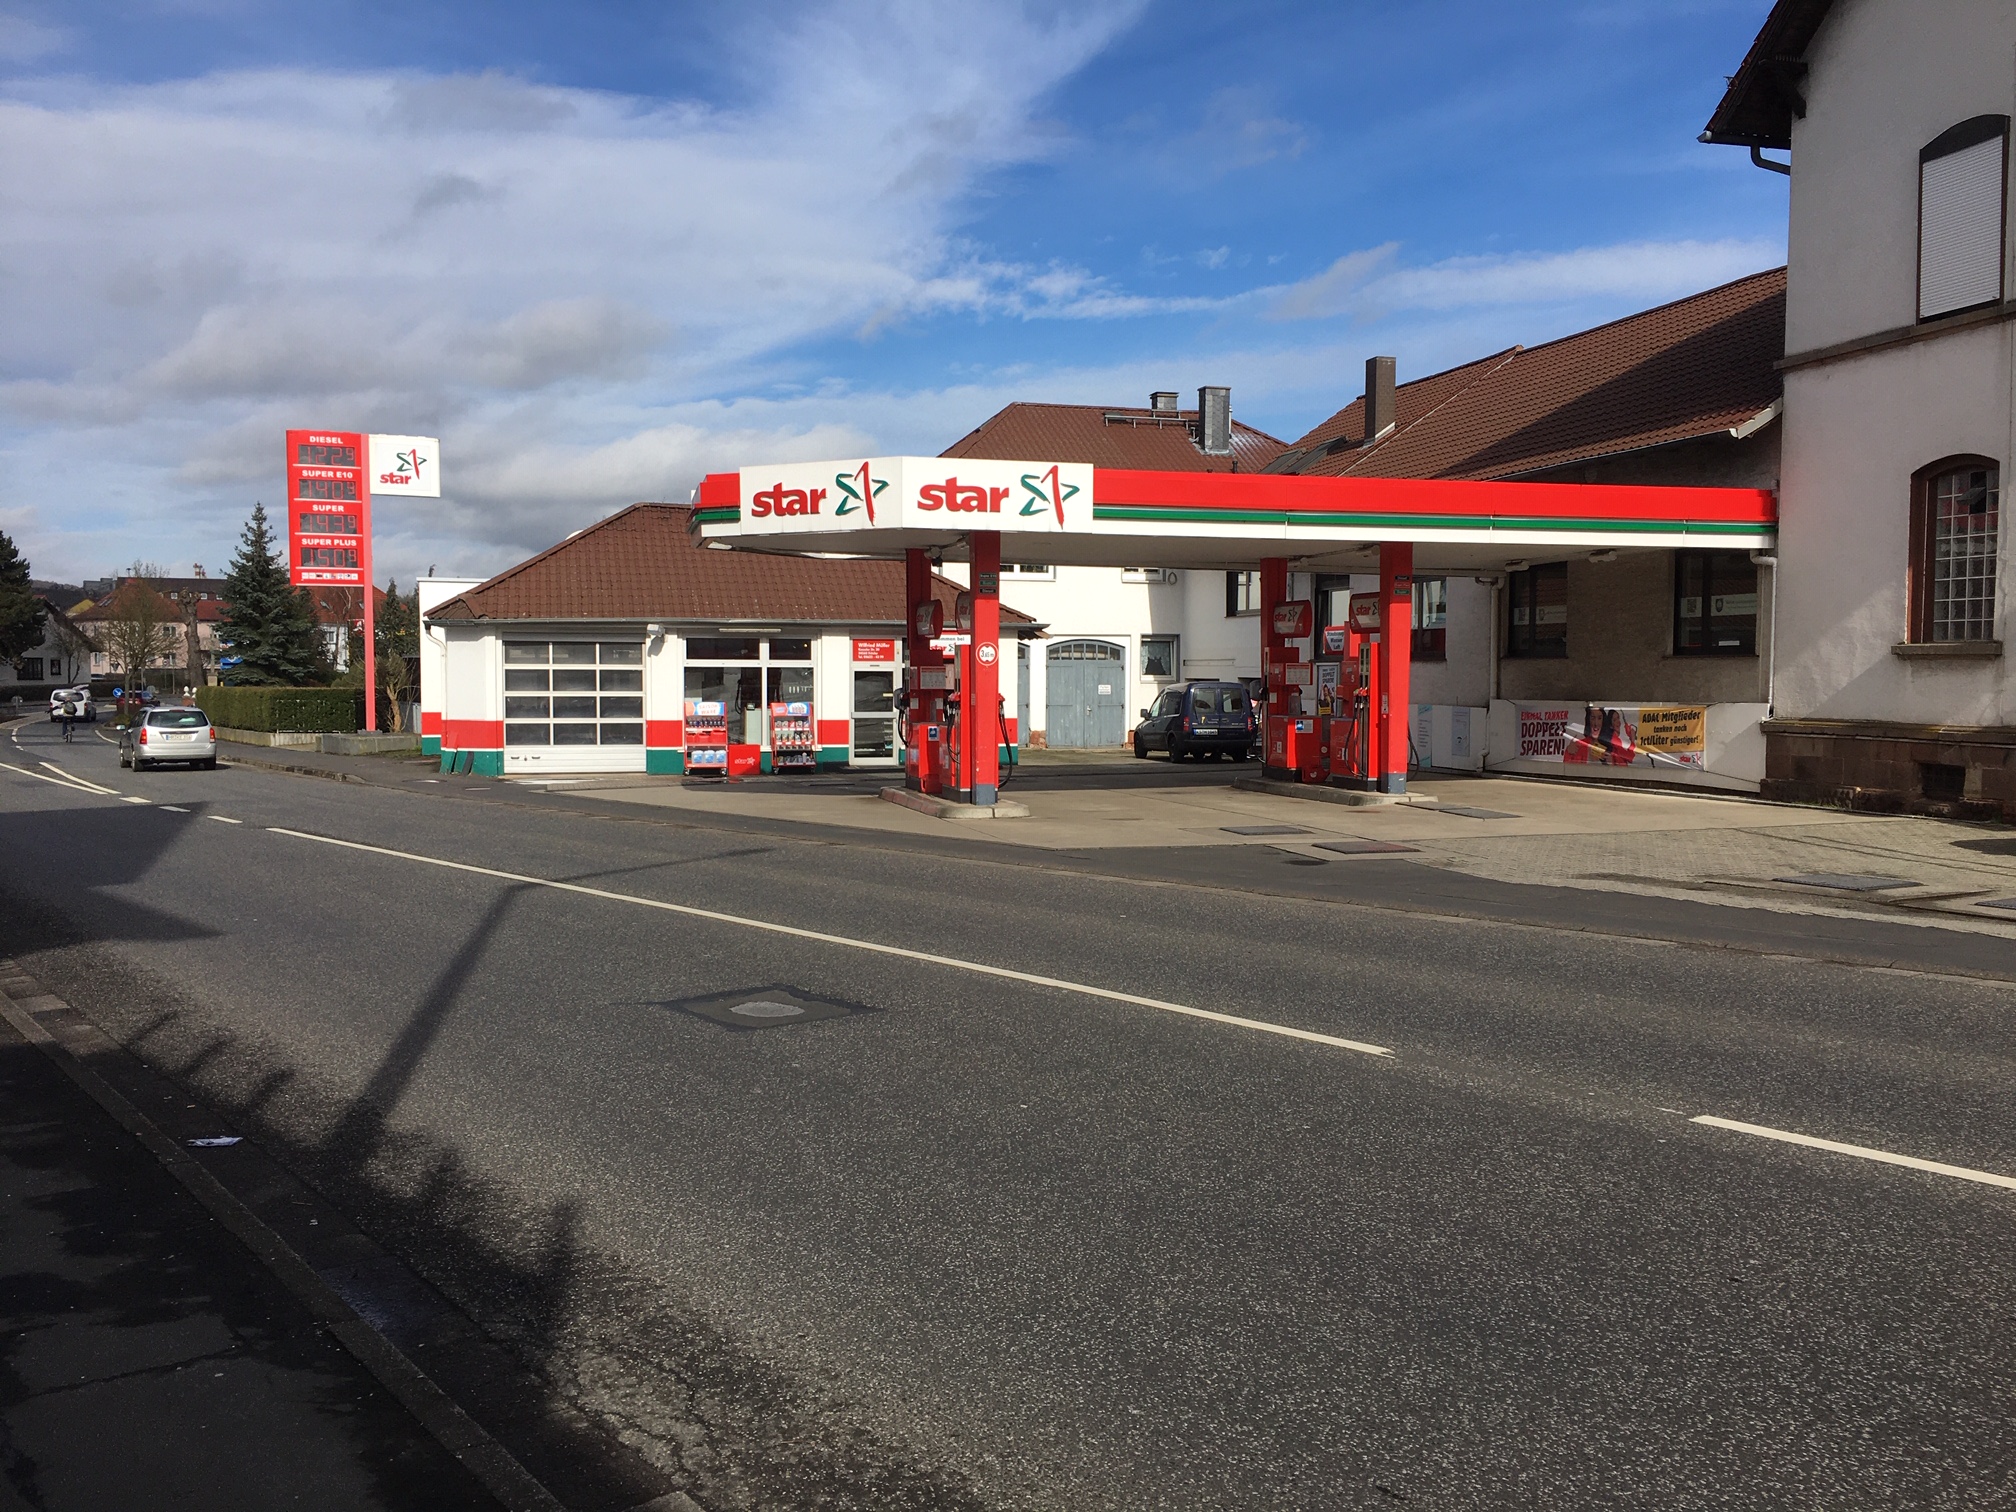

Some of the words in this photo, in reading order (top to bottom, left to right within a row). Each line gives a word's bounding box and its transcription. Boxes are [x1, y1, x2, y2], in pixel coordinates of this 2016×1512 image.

[309, 435, 343, 444] DIESEL
[302, 470, 334, 478] SUPER
[336, 471, 353, 479] E10
[380, 472, 411, 485] star
[751, 482, 827, 517] star
[917, 477, 1009, 513] star
[312, 504, 344, 512] SUPER
[301, 538, 332, 546] SUPER
[1356, 605, 1371, 616] star
[1274, 612, 1287, 622] star
[1521, 711, 1543, 721] EINMAL
[1544, 710, 1569, 720] TANKEN
[1642, 713, 1659, 723] ADAC
[1661, 710, 1701, 724] Mitglieder
[1521, 721, 1568, 738] DOPPELT
[1653, 725, 1672, 733] tanken
[1674, 724, 1687, 732] noch
[1640, 735, 1669, 746] 1ct/Liter
[1670, 735, 1699, 746] günstiger!
[1520, 738, 1565, 756] SPAREN!
